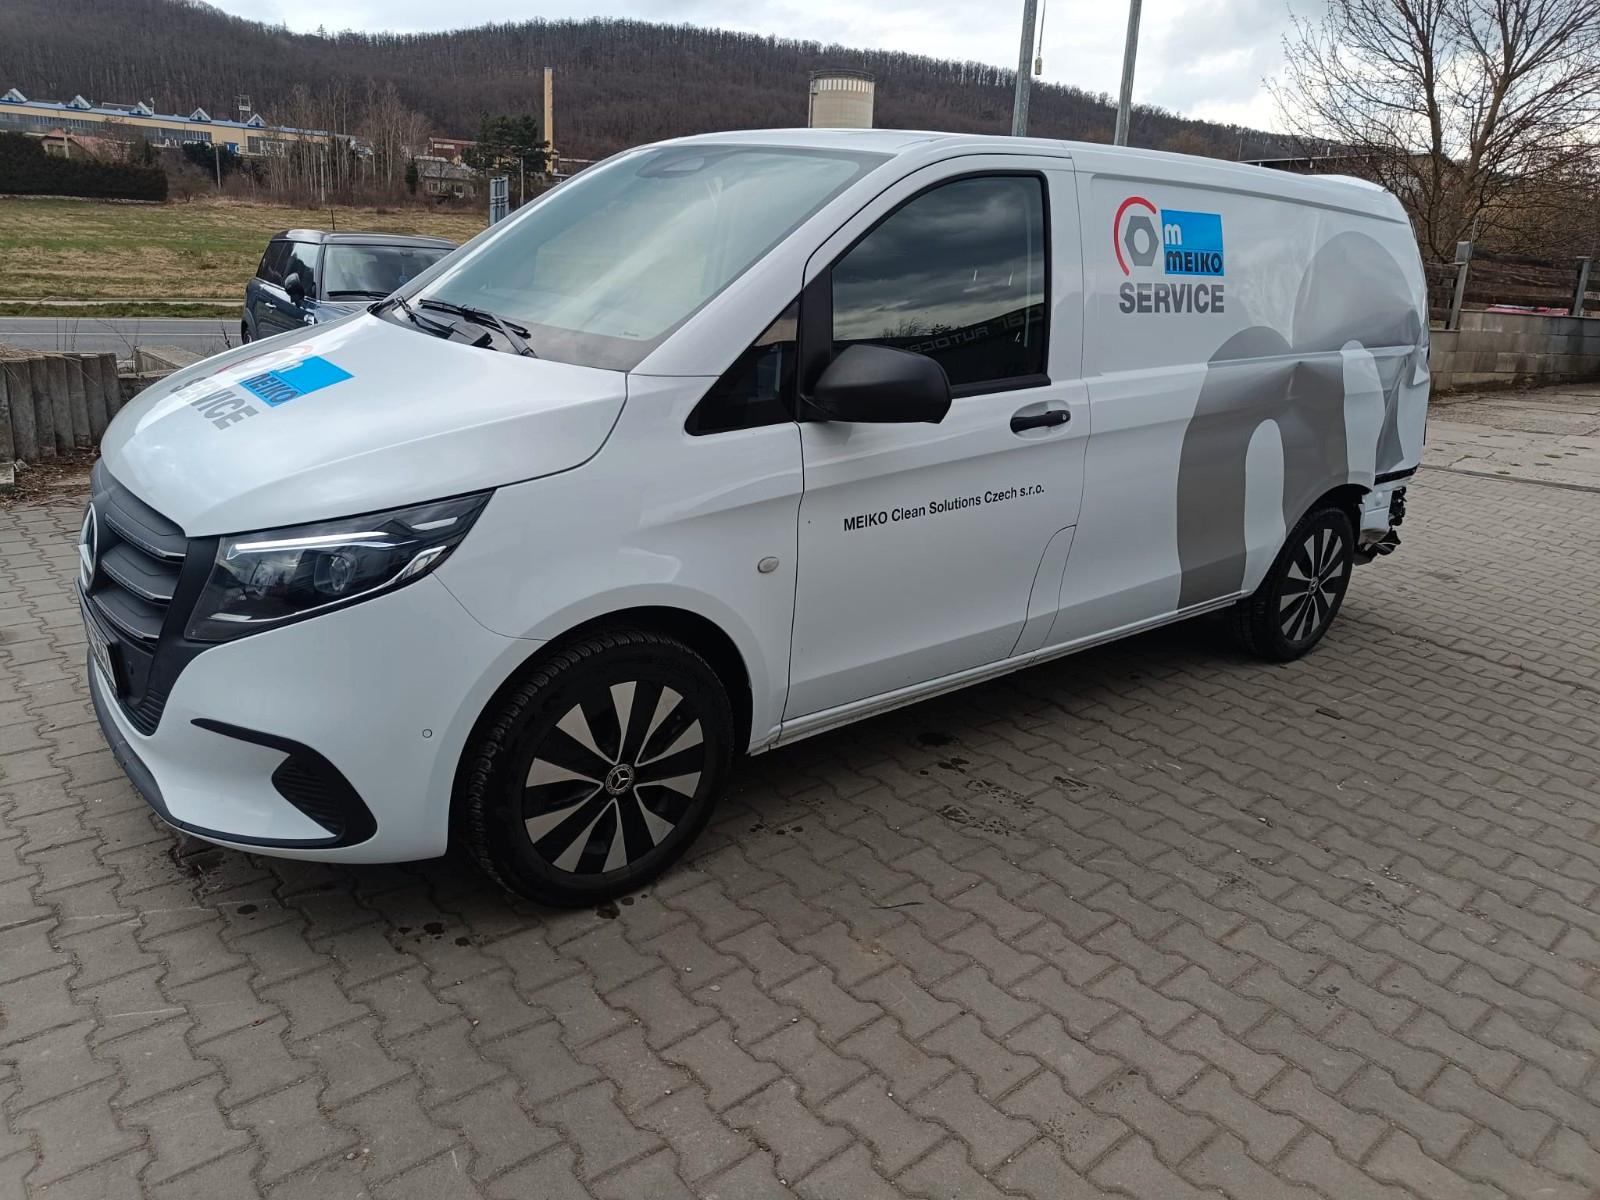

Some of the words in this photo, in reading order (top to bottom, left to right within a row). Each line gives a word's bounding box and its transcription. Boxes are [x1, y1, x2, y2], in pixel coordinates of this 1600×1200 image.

[1165, 250, 1223, 273] MEIKO
[1119, 281, 1225, 314] SERVICE
[843, 511, 888, 532] MEIKO
[891, 505, 926, 522] Clean
[929, 495, 981, 515] Solutions
[984, 486, 1017, 504] Czech
[1019, 483, 1045, 497] s.r.o.
